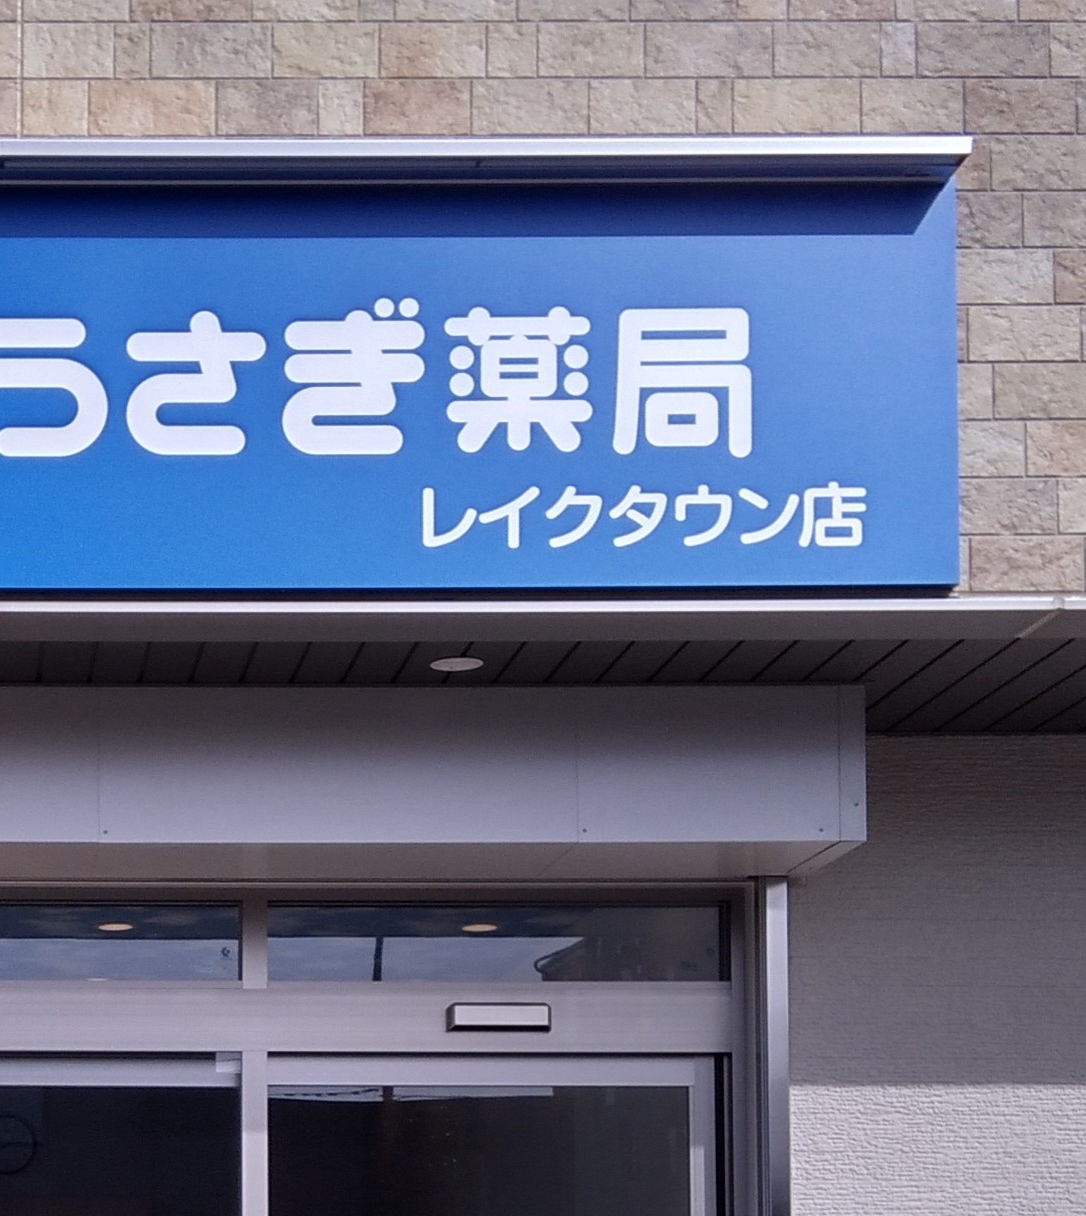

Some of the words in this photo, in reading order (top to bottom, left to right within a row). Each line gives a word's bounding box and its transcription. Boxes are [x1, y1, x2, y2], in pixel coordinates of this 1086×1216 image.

[422, 481, 867, 549] レイクタウン店
